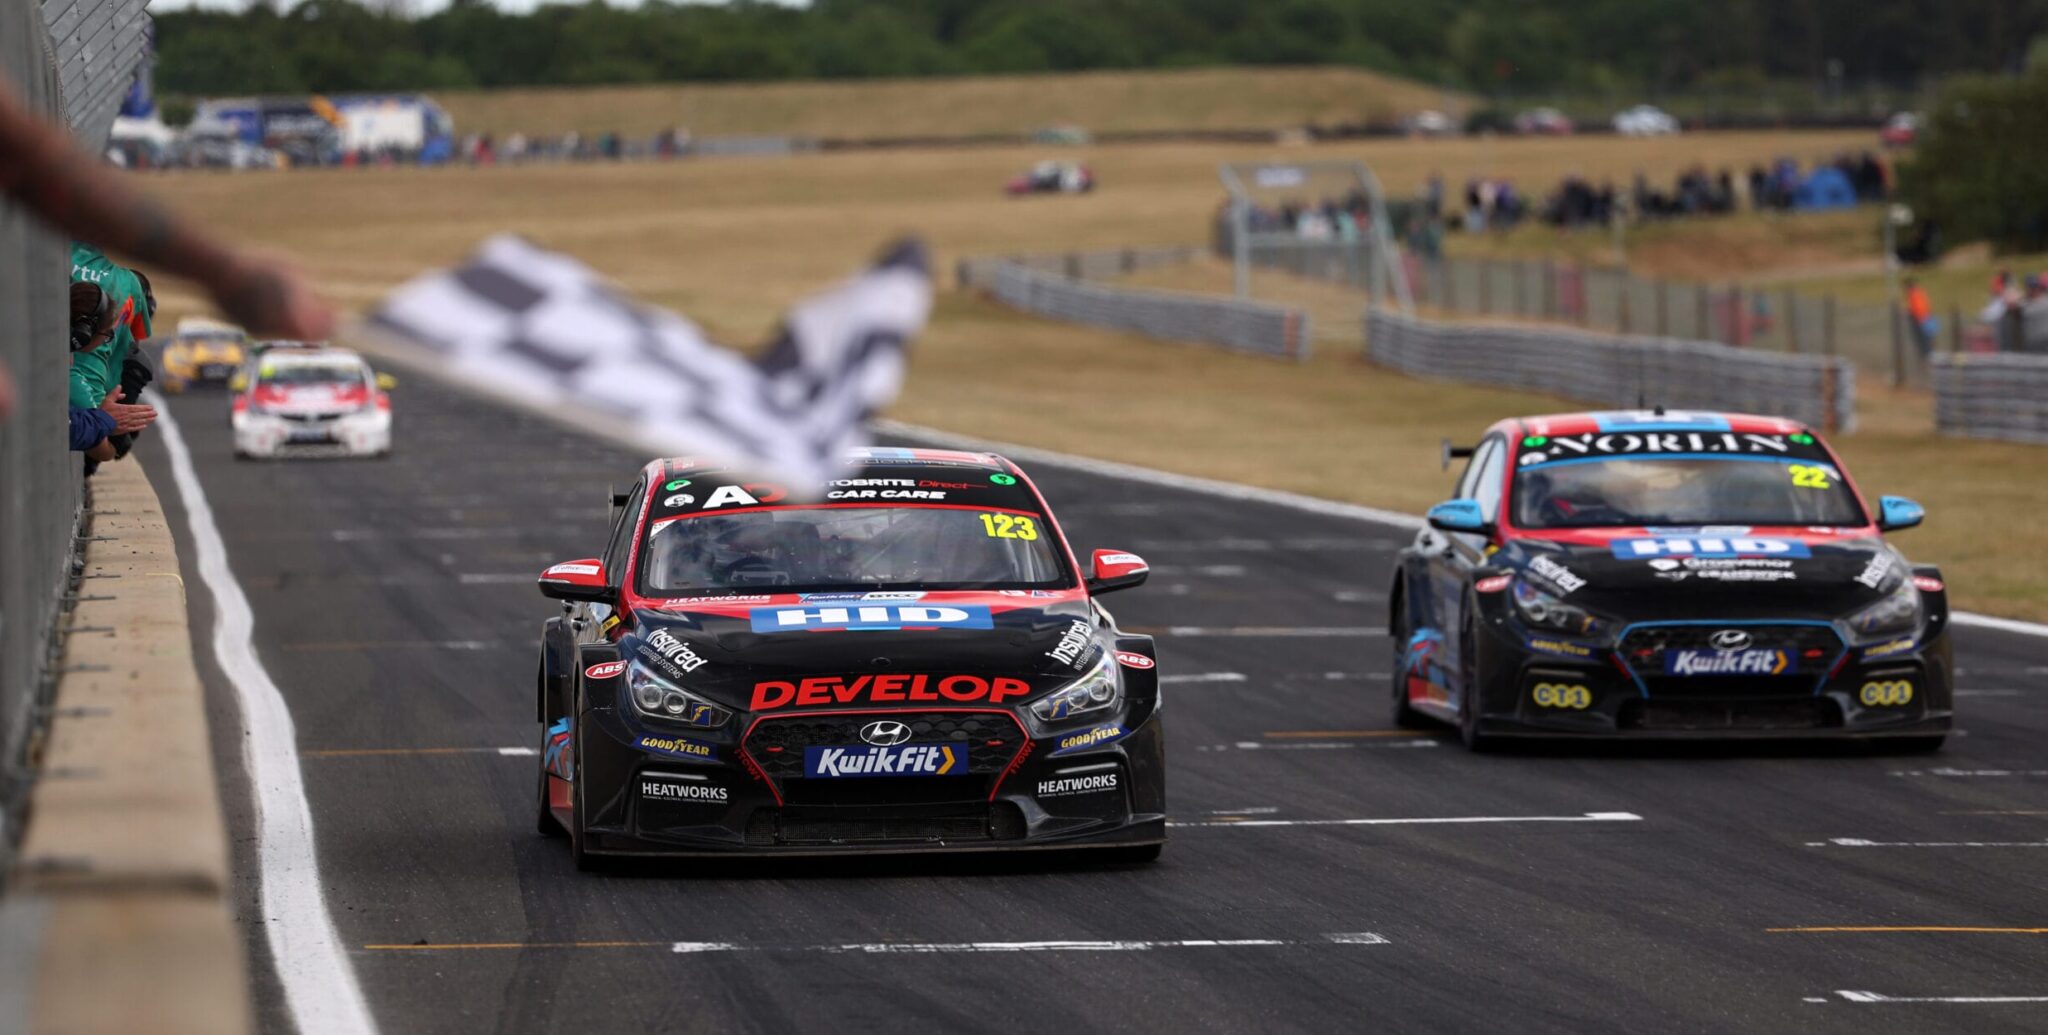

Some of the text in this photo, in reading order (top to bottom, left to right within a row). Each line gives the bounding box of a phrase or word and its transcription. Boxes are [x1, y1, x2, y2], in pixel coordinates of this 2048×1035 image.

[1550, 433, 1789, 453] NORLIN
[827, 478, 968, 490] TOBRITE Direct
[1789, 465, 1830, 489] 22
[827, 490, 947, 500] CAR CARE
[979, 513, 1038, 541] 123
[1630, 539, 1790, 555] HID
[665, 594, 772, 605] HEATWORKS
[776, 606, 970, 626] HID
[646, 627, 709, 673] inspired
[1044, 619, 1093, 665] inspired
[592, 662, 624, 676] ABS
[657, 656, 684, 680] SYSTEMS
[1118, 654, 1149, 666] ABS
[750, 674, 1030, 711] DEVELOP
[642, 782, 728, 800] HEATWORKS
[1037, 774, 1118, 794] HEATWORKS
